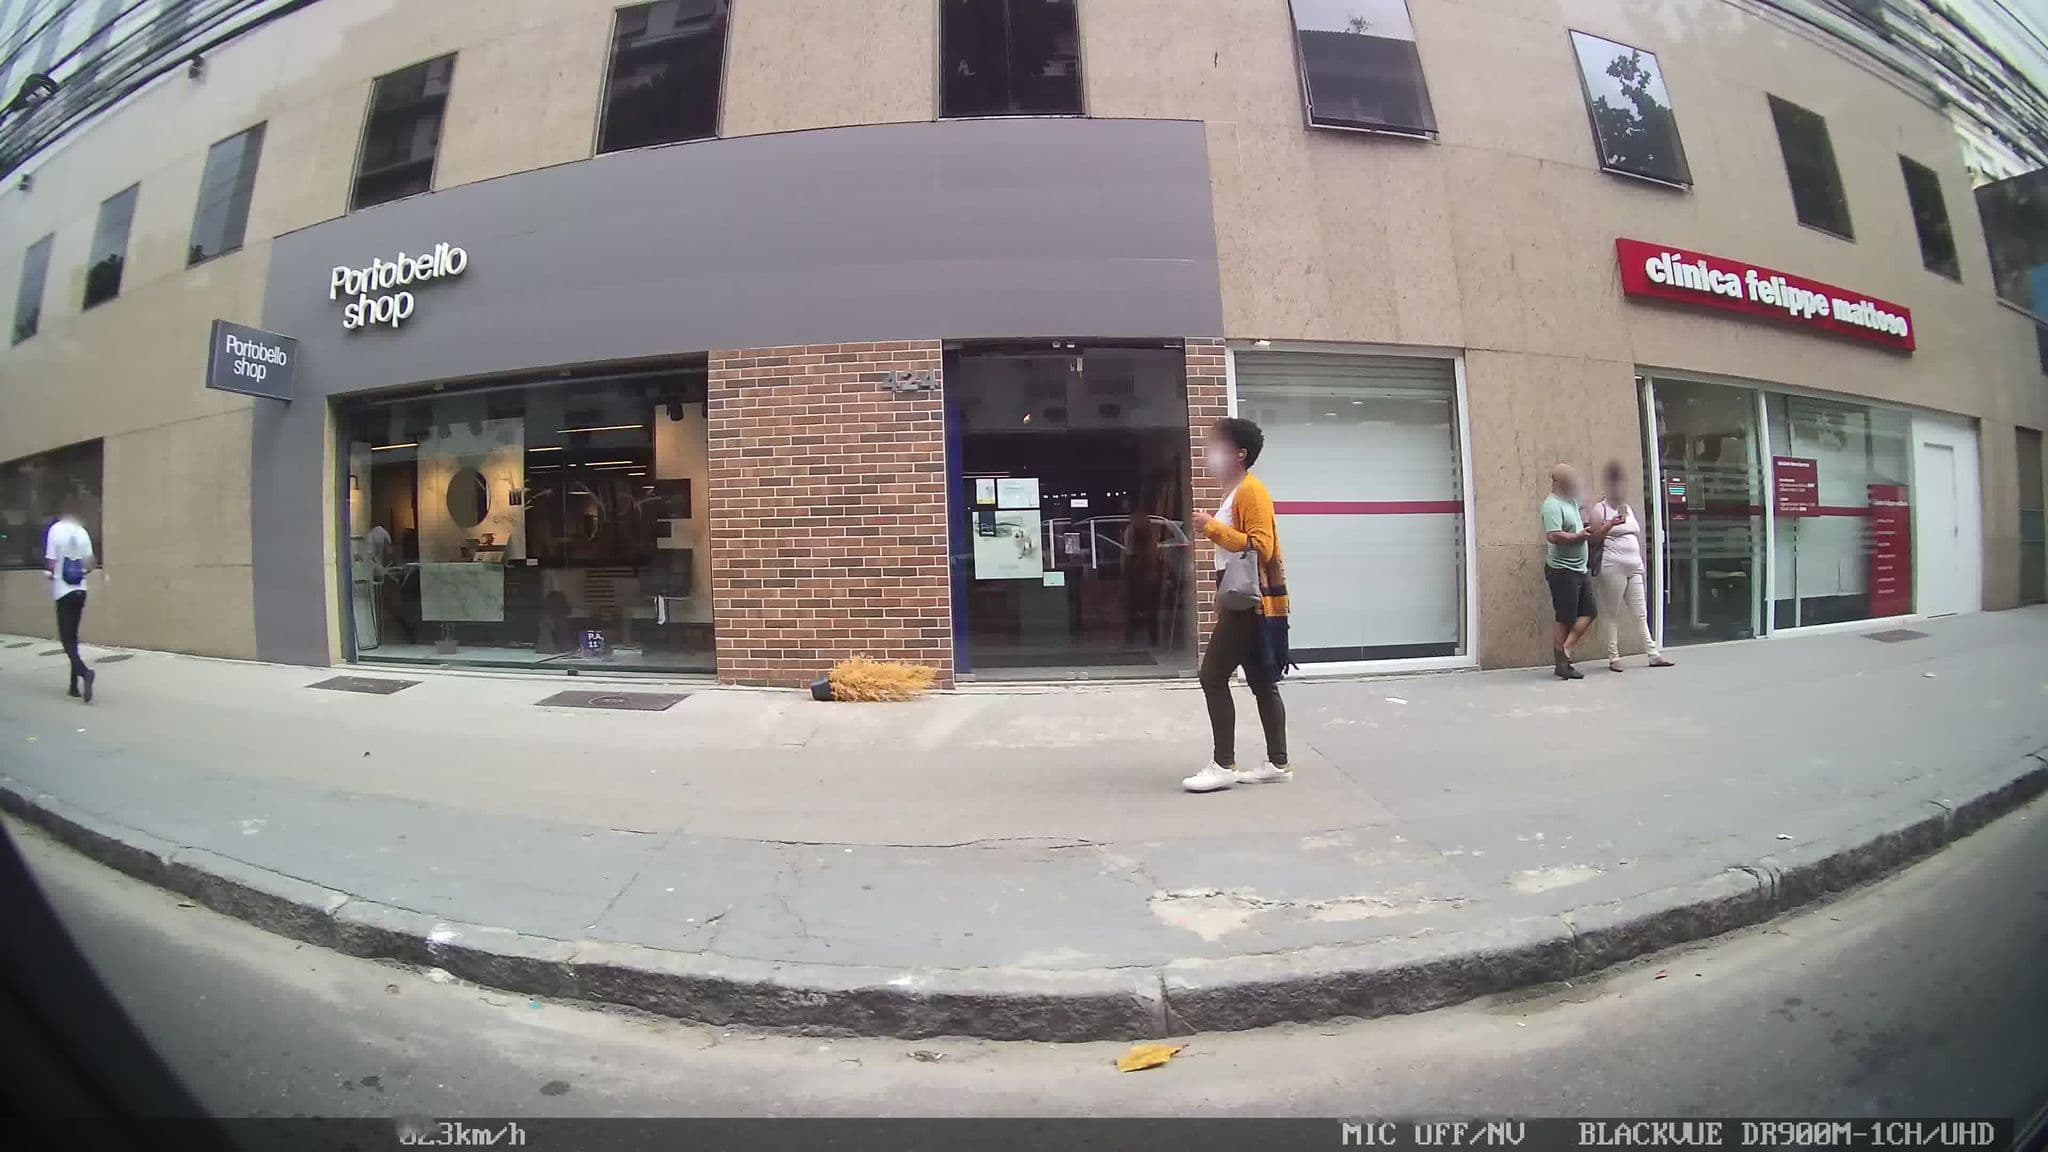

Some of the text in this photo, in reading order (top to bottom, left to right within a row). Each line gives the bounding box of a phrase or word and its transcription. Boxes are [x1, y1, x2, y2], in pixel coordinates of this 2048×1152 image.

[330, 242, 467, 300] Portobello
[343, 291, 414, 329] shop
[1645, 252, 1908, 337] clínica felippe mattoso
[226, 334, 287, 366] Portobello
[233, 357, 267, 382] shop
